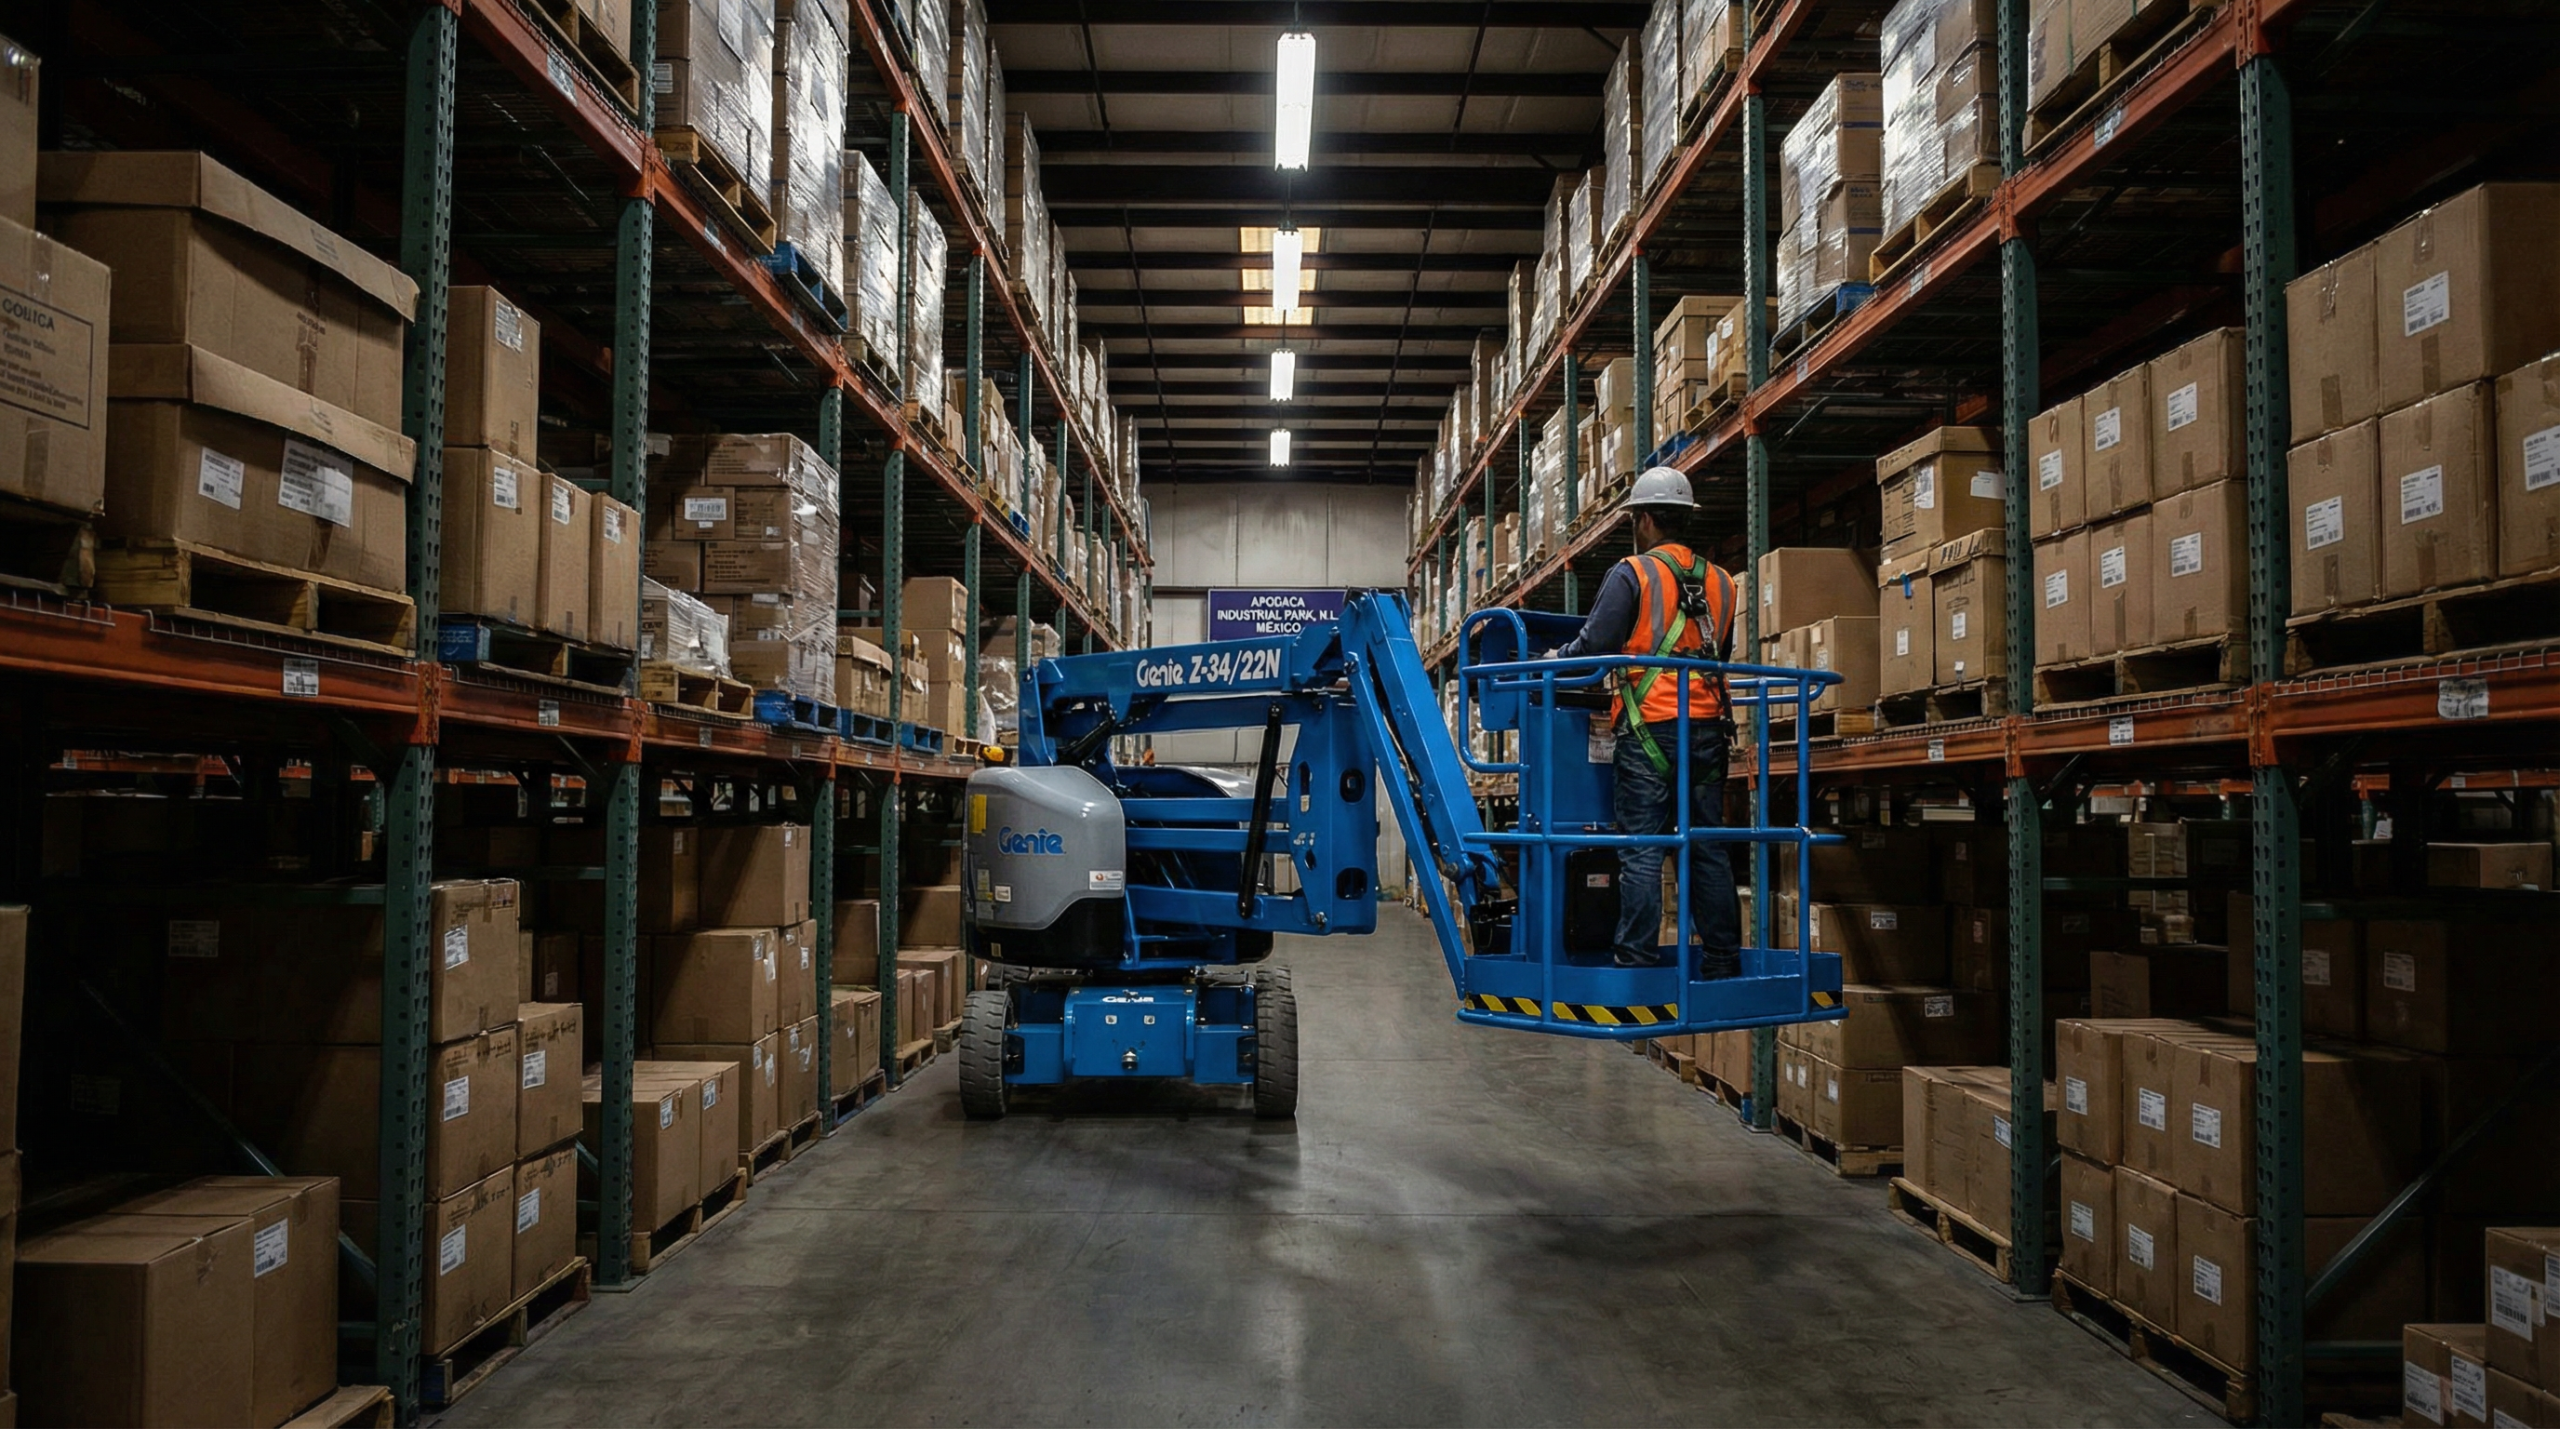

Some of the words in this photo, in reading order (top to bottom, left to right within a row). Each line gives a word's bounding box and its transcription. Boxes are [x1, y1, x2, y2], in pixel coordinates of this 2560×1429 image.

[1217, 609, 1282, 621] INDUSTRIAL
[1136, 658, 1184, 688] Genie
[1189, 648, 1281, 685] Z-34/22N
[998, 826, 1065, 855] Genie
